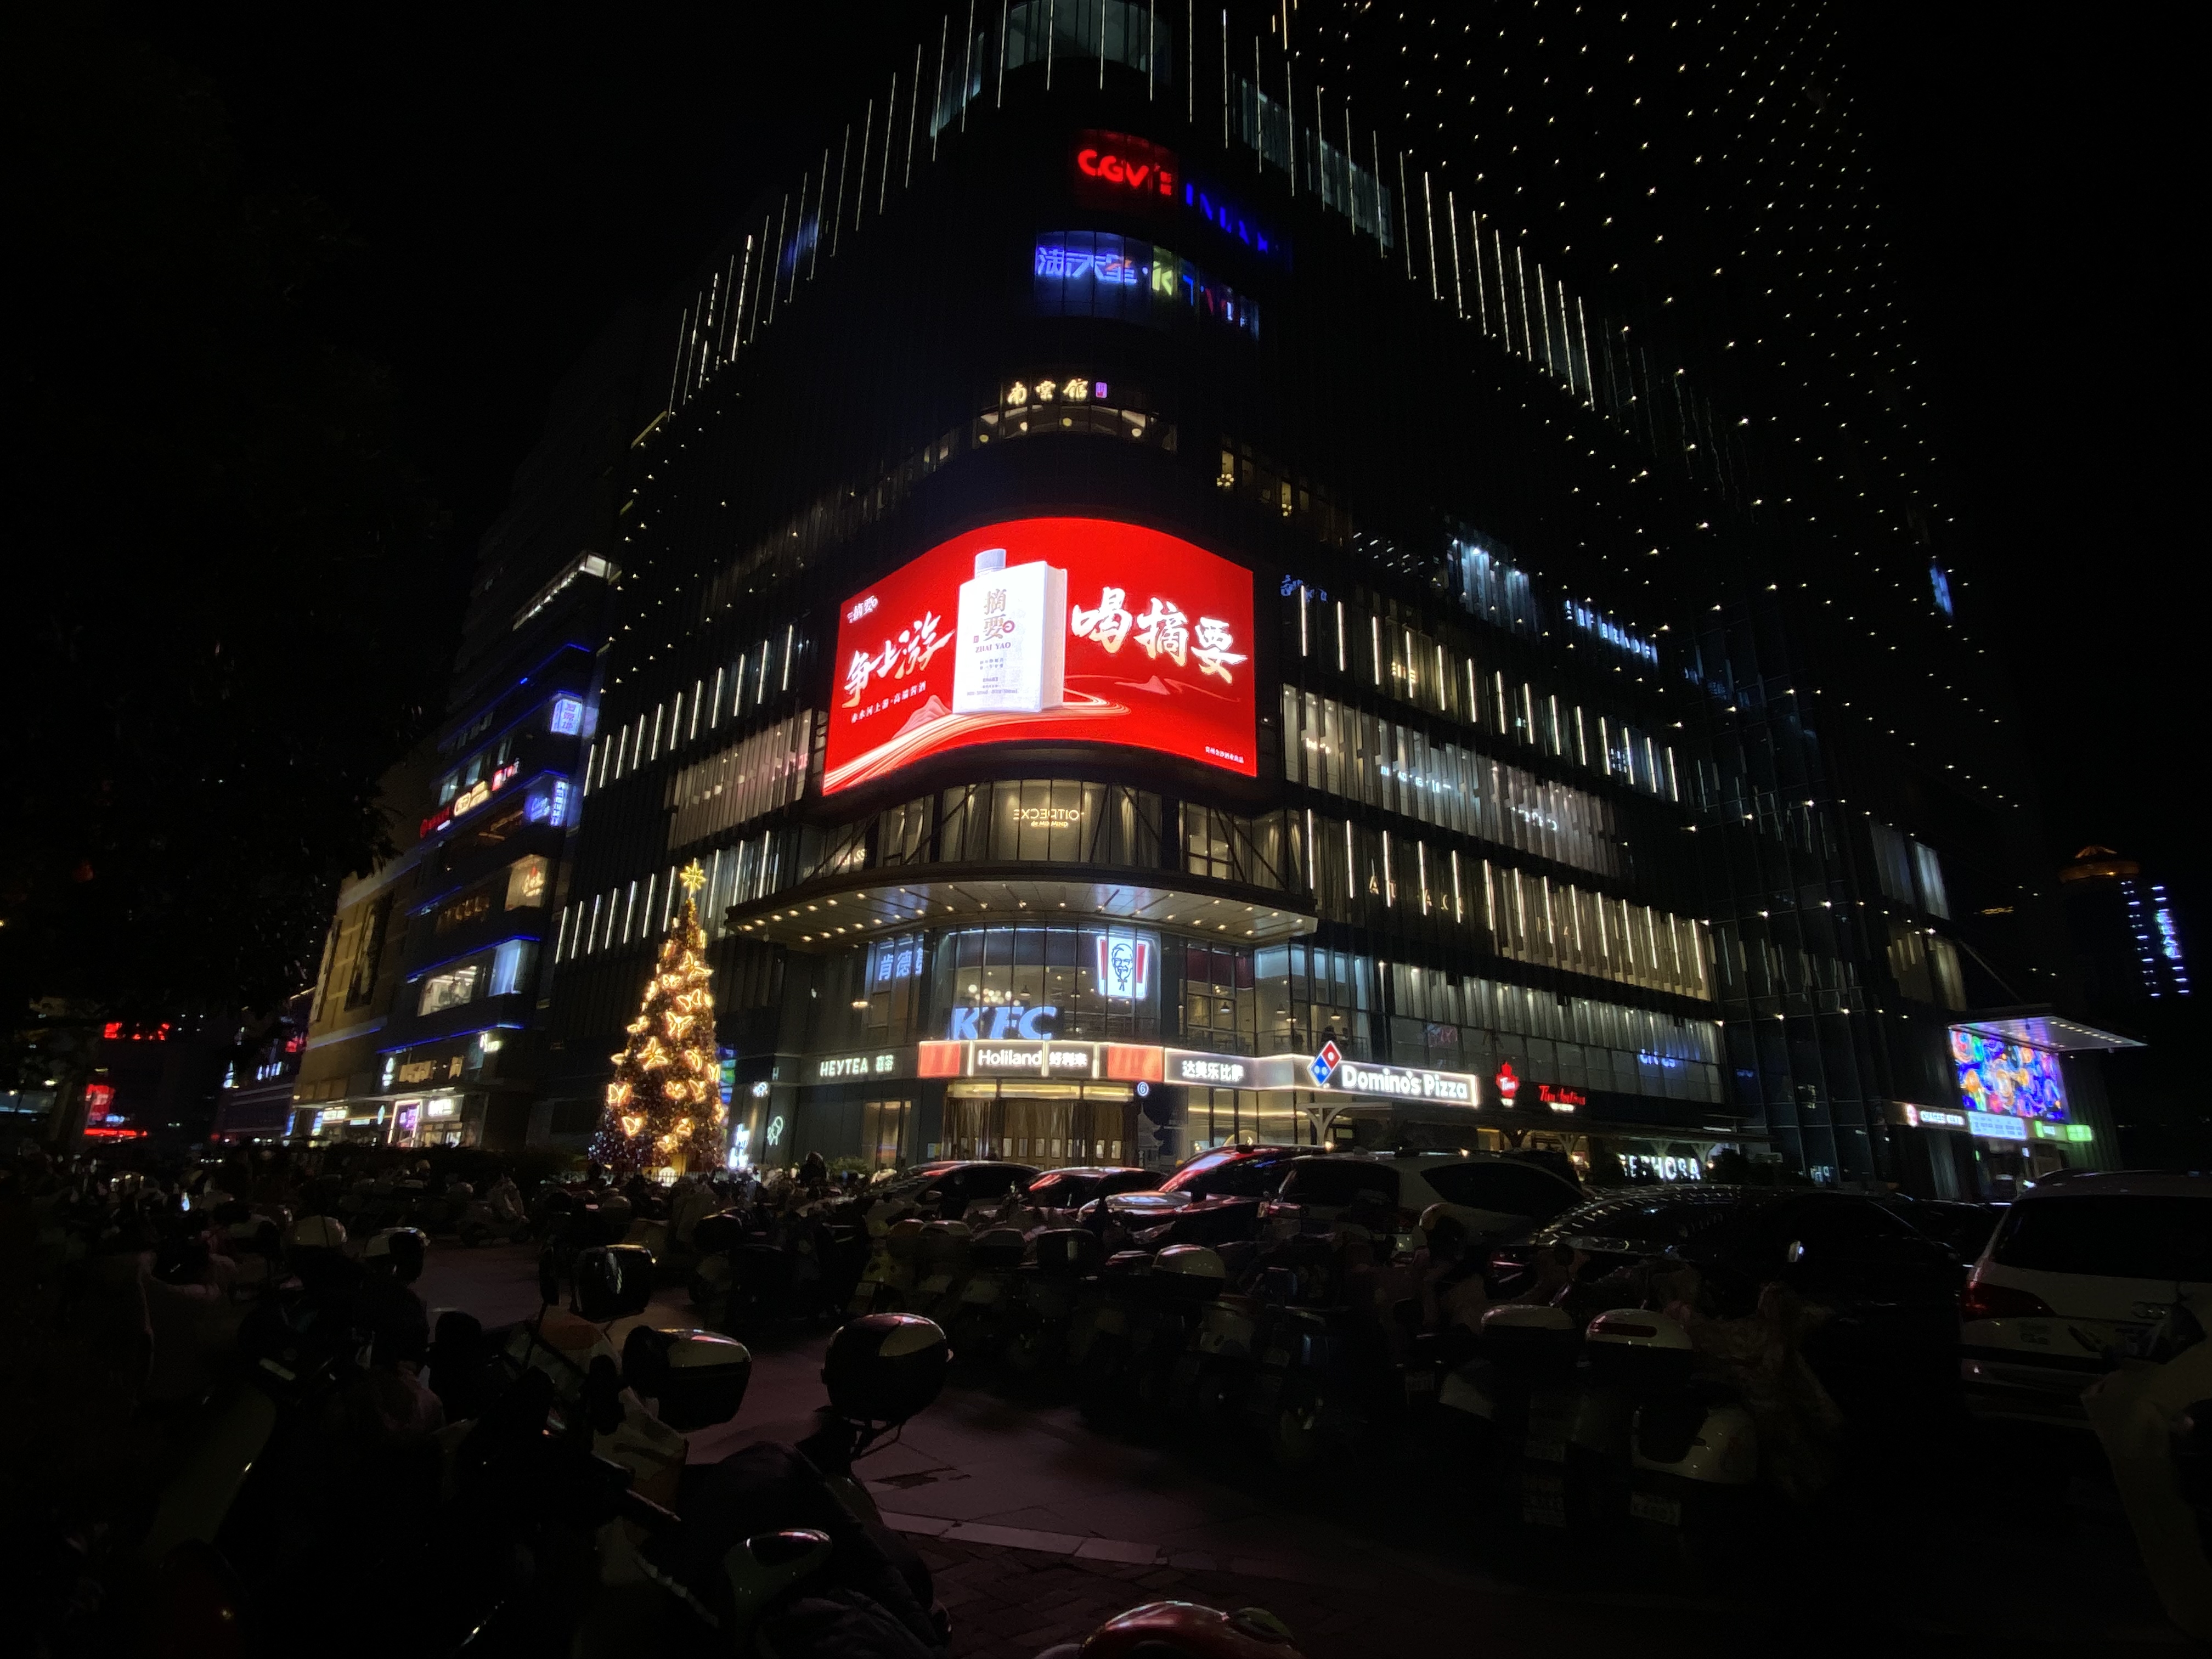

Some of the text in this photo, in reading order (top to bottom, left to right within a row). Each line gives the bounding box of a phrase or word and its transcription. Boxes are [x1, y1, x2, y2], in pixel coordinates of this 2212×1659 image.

[1078, 149, 1149, 188] CGV
[995, 641, 1012, 650] YAO
[1071, 586, 1248, 684] 喝摘要
[842, 611, 956, 708] 争上游
[949, 1006, 1058, 1041] KFC
[820, 1054, 894, 1077] HEYTEA 喜茶
[978, 1049, 1088, 1067] Holiland 好利来
[1182, 1060, 1245, 1082] 达美乐比萨
[1341, 1064, 1469, 1098] Domino's Pizza
